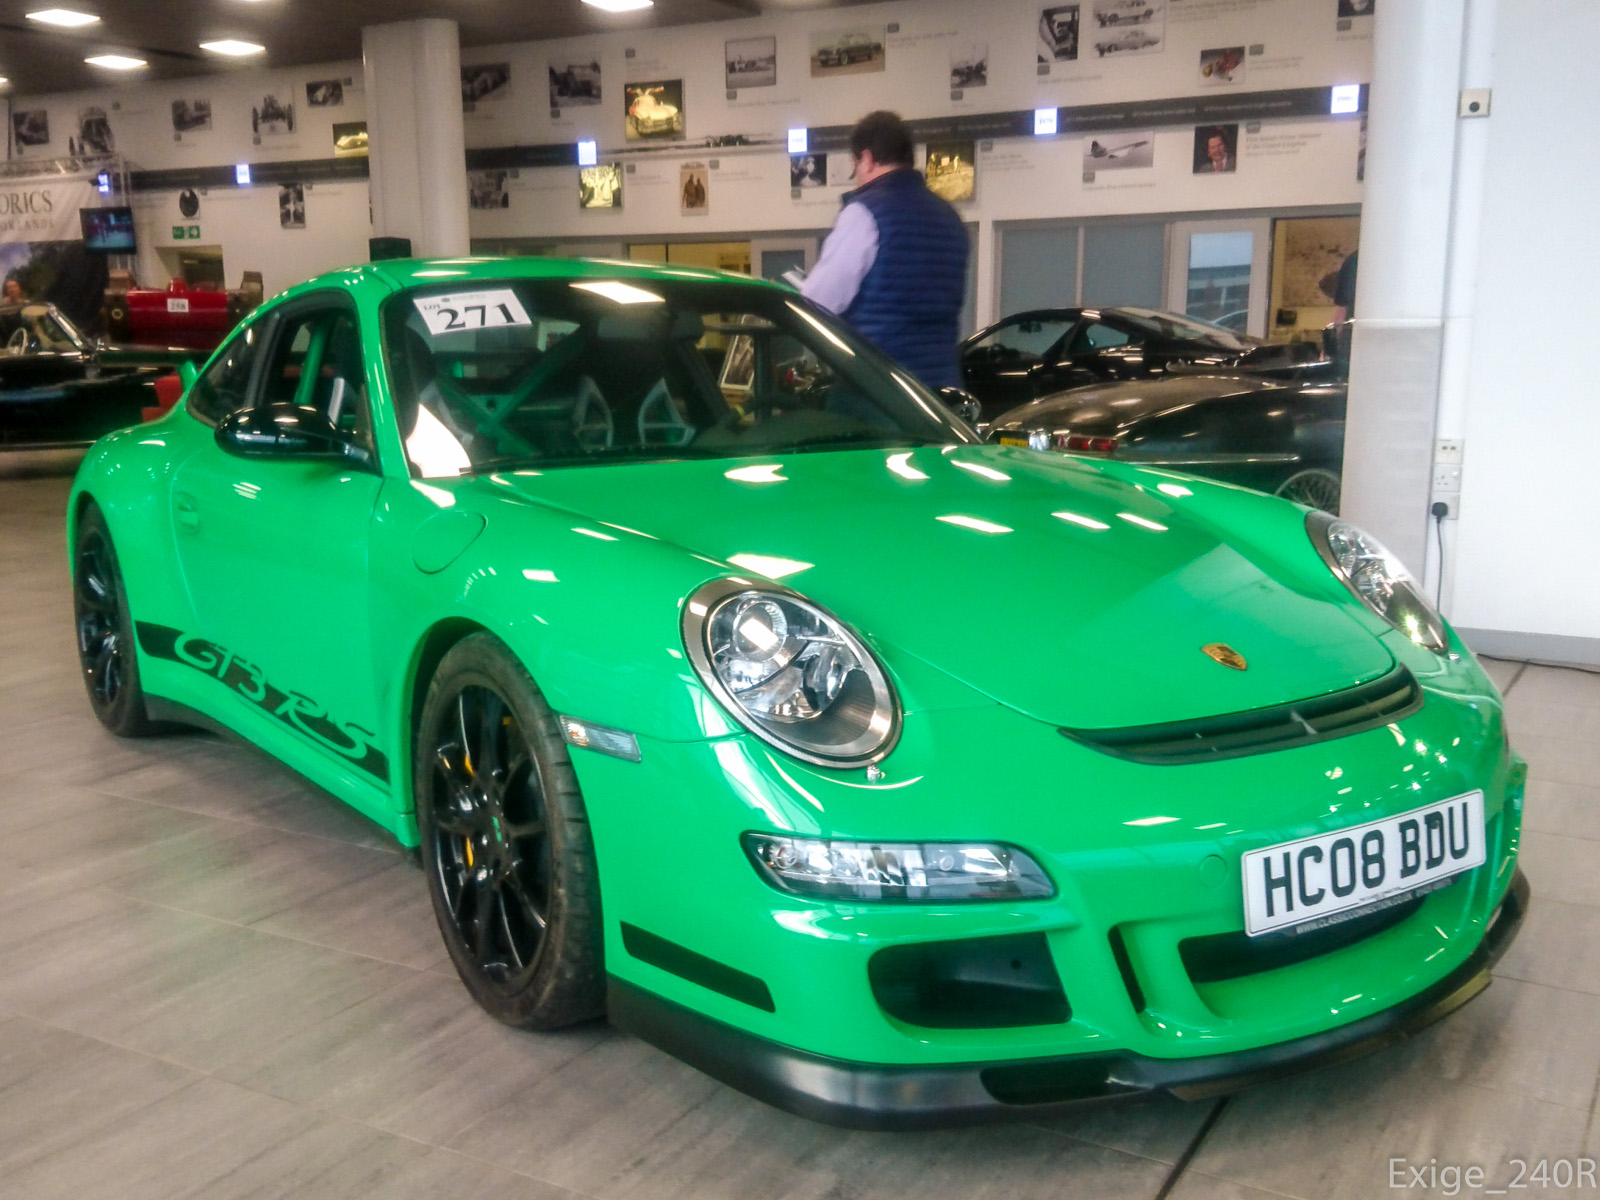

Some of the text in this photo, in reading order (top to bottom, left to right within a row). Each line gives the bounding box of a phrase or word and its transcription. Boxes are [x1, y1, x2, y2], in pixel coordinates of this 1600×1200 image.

[0, 190, 53, 215] ORICS
[436, 302, 522, 329] 271
[174, 632, 376, 760] GT3 RS
[1263, 829, 1386, 918] HC08
[1398, 802, 1469, 879] BDU
